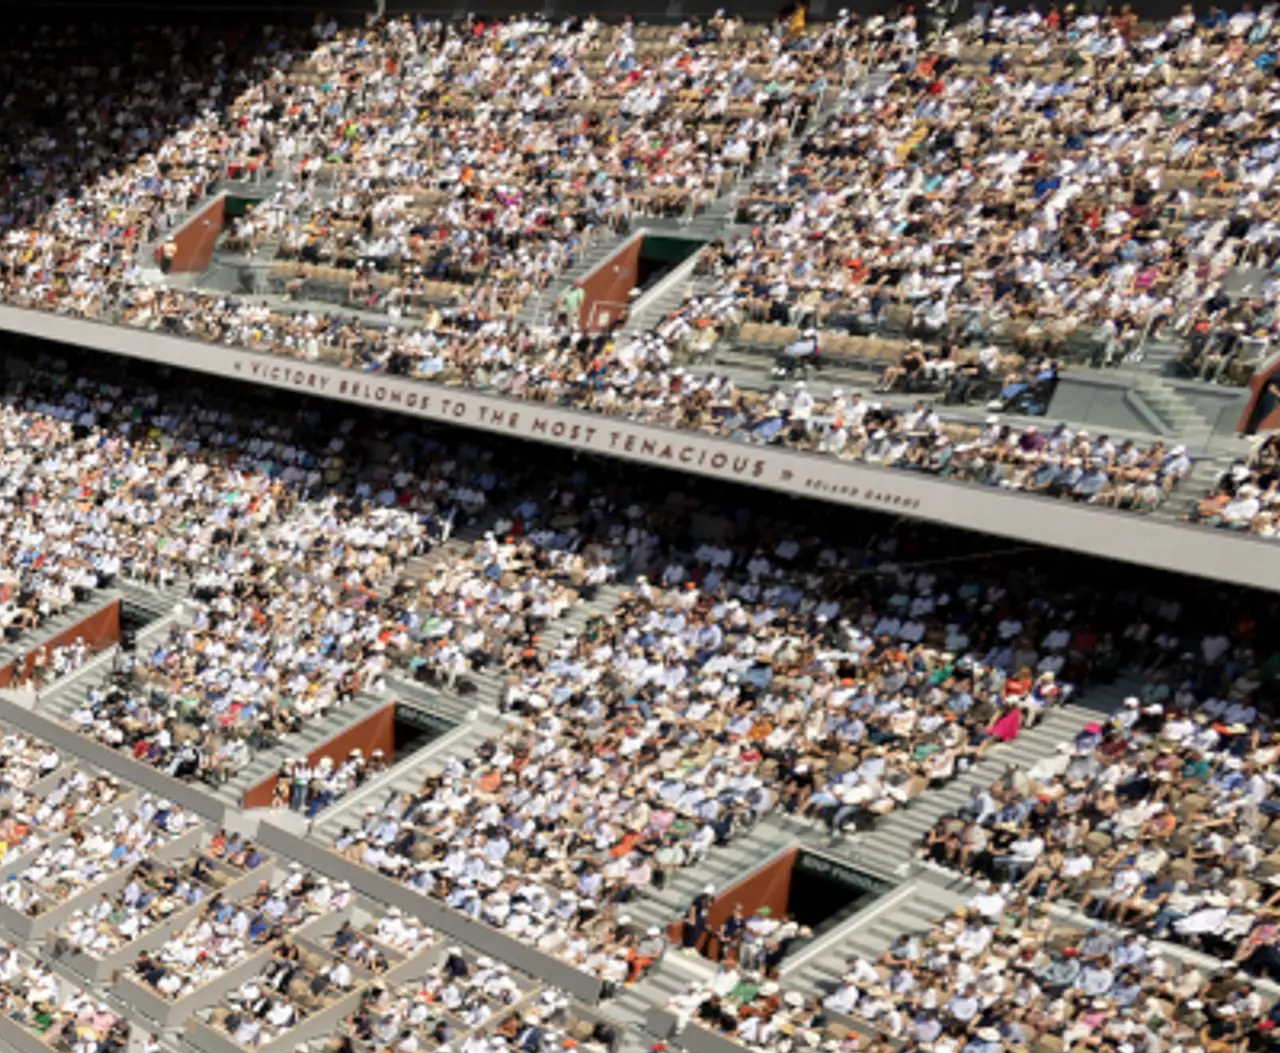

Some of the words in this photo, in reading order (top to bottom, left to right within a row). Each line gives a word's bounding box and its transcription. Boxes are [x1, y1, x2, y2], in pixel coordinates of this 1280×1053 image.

[250, 361, 330, 390] VICTORY
[339, 379, 431, 410] BELONGS
[441, 399, 466, 417] TO
[479, 406, 520, 429] THE
[532, 417, 597, 443] MOST
[609, 431, 766, 477] TENACIOUS
